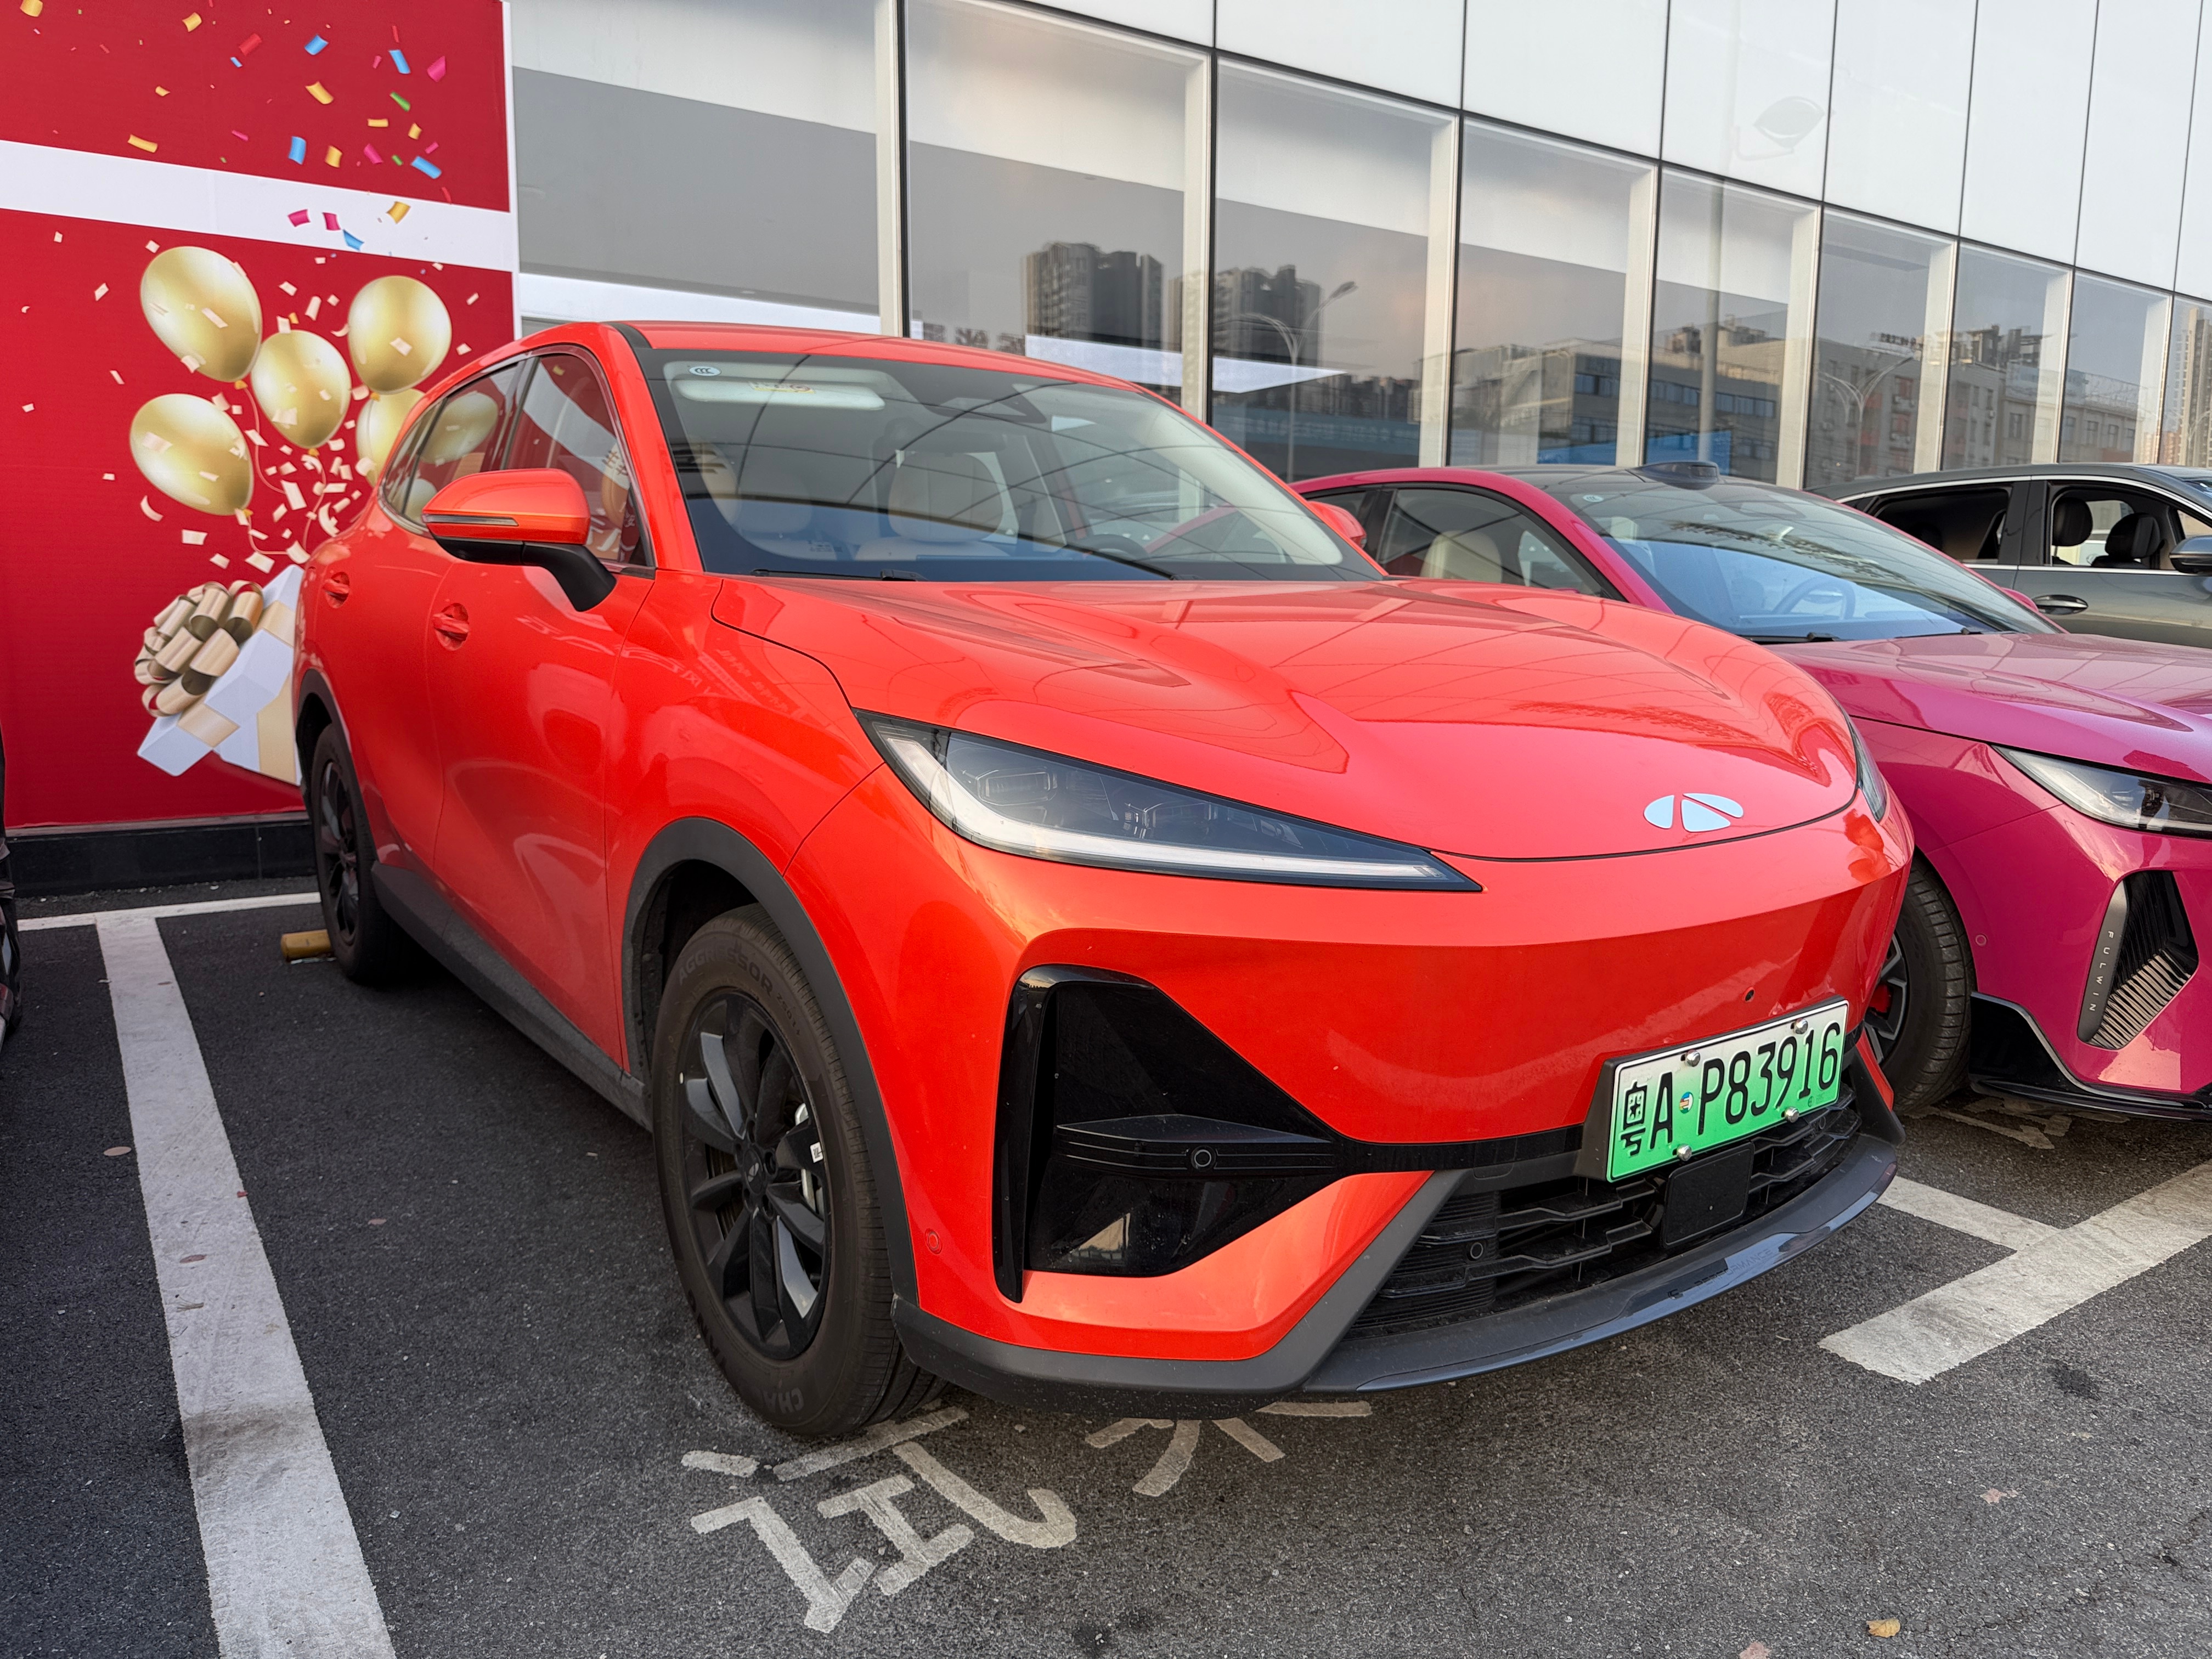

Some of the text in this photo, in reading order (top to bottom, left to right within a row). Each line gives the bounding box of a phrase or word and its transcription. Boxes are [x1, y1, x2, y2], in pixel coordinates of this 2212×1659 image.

[679, 943, 774, 997] AGGRESSOR
[2089, 930, 2115, 1012] FULWIN
[1620, 1071, 1673, 1157] 粤A
[1697, 1022, 1841, 1135] P83916
